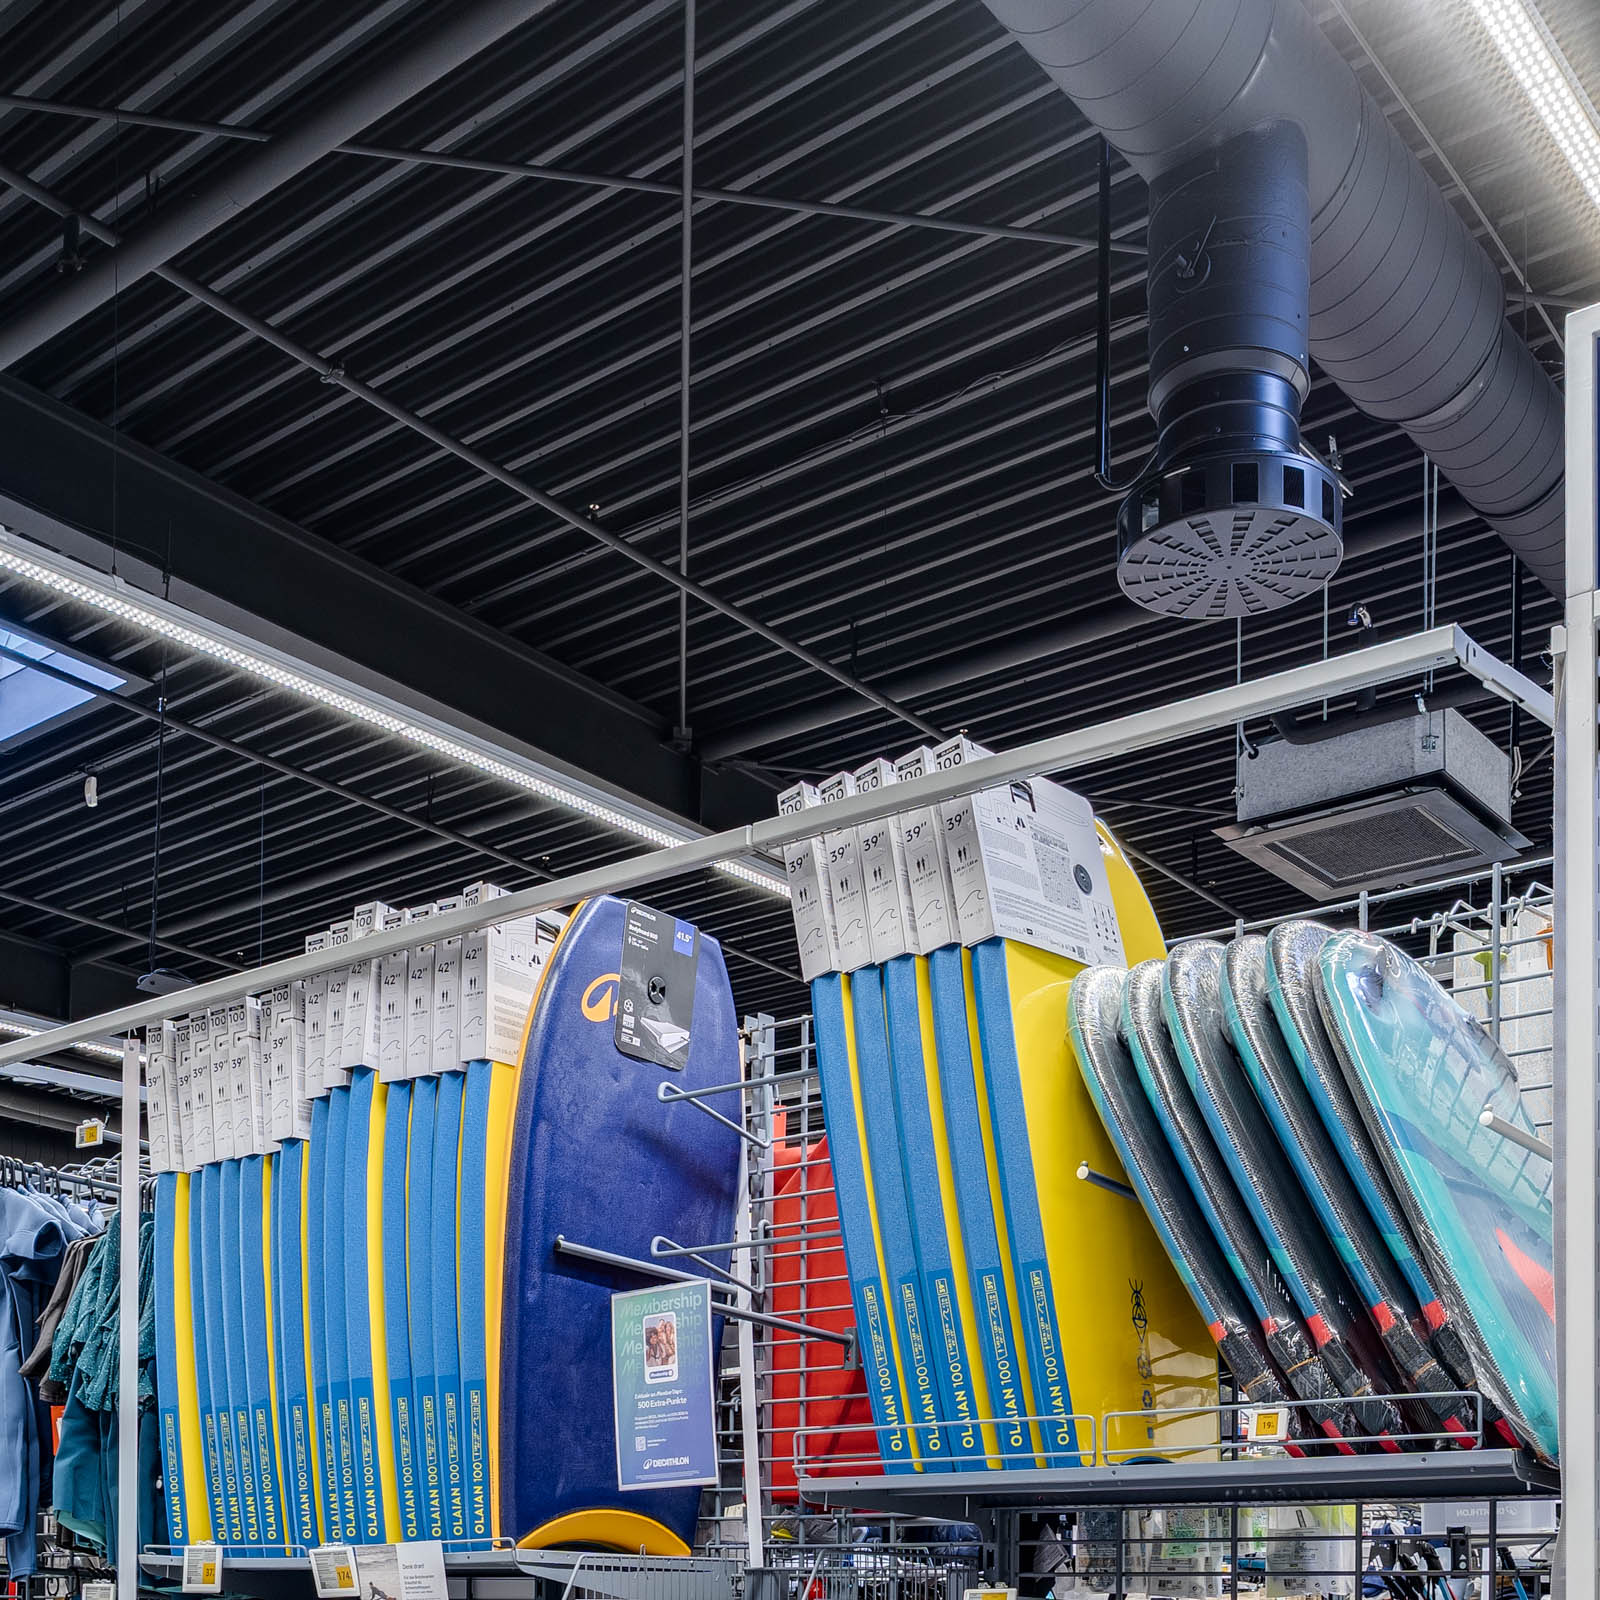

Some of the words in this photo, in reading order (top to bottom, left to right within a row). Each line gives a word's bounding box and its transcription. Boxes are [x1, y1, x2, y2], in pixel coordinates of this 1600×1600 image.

[936, 752, 962, 770] 100
[856, 776, 879, 794] 100
[781, 800, 801, 816] 100
[272, 990, 289, 1003] 100
[190, 1020, 206, 1033] 100
[211, 1015, 227, 1027] 100
[229, 1011, 245, 1024] 100
[147, 1032, 161, 1044] 100
[620, 1291, 702, 1318] Membership
[878, 1367, 892, 1392] 100
[916, 1366, 930, 1391] 100
[950, 1362, 964, 1387] 100
[998, 1360, 1012, 1385] 100
[1044, 1357, 1059, 1383] 100
[637, 1401, 650, 1409] 500
[472, 1462, 483, 1482] 100
[653, 1456, 690, 1468] DECATHLON
[262, 1474, 272, 1493] 100
[297, 1472, 308, 1491] 100
[342, 1467, 353, 1487] 100
[363, 1466, 374, 1487] 100
[402, 1466, 413, 1487] 100
[427, 1466, 438, 1486] 100
[449, 1464, 460, 1484] 100
[169, 1476, 179, 1493] 100
[226, 1476, 236, 1494] 100
[243, 1475, 254, 1494] 100
[171, 1496, 182, 1539] OLAIAN
[228, 1497, 242, 1540] OLAIAN
[246, 1496, 258, 1540] OLAIAN
[264, 1495, 277, 1539] OLAIAN
[300, 1494, 312, 1539] OLAIAN
[344, 1490, 356, 1537] OLAIAN
[365, 1489, 378, 1536] OLAIAN
[404, 1490, 417, 1537] OLAIAN
[429, 1489, 442, 1537] OLAIAN
[451, 1487, 463, 1536] OLAIAN
[473, 1485, 485, 1534] OLAIAN
